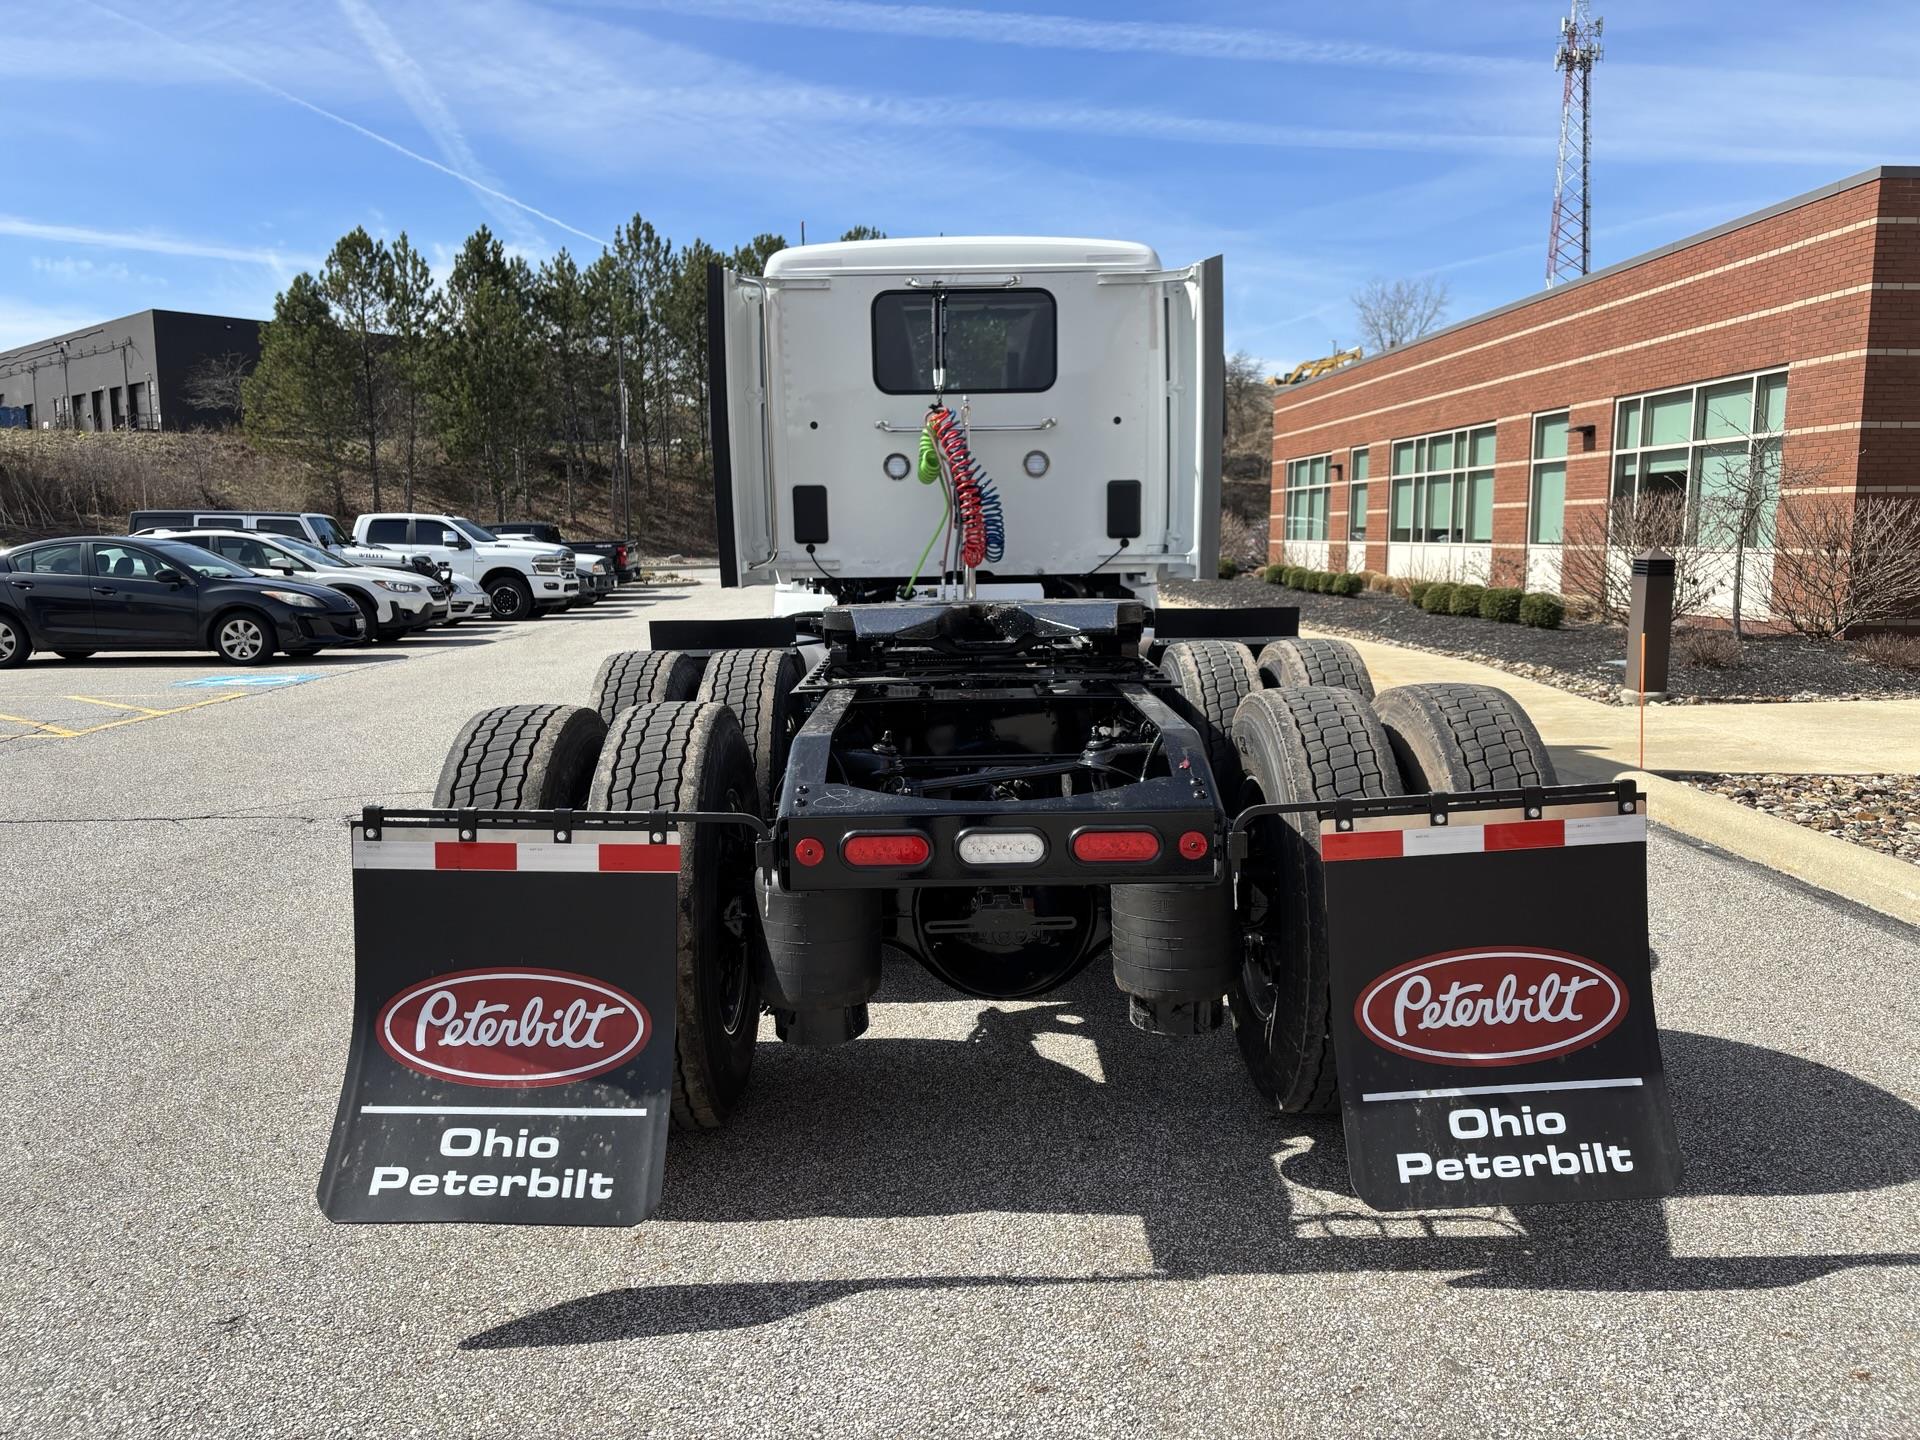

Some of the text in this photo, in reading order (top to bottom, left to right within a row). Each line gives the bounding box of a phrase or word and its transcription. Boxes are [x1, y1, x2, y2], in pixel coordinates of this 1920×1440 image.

[415, 989, 626, 1052] Peterbilt
[1393, 973, 1600, 1037] Peterbilt
[1448, 1105, 1567, 1140] Ohio
[439, 1127, 560, 1159] Ohio
[368, 1164, 614, 1200] Peterbilt
[1396, 1142, 1634, 1184] Peterbilt
